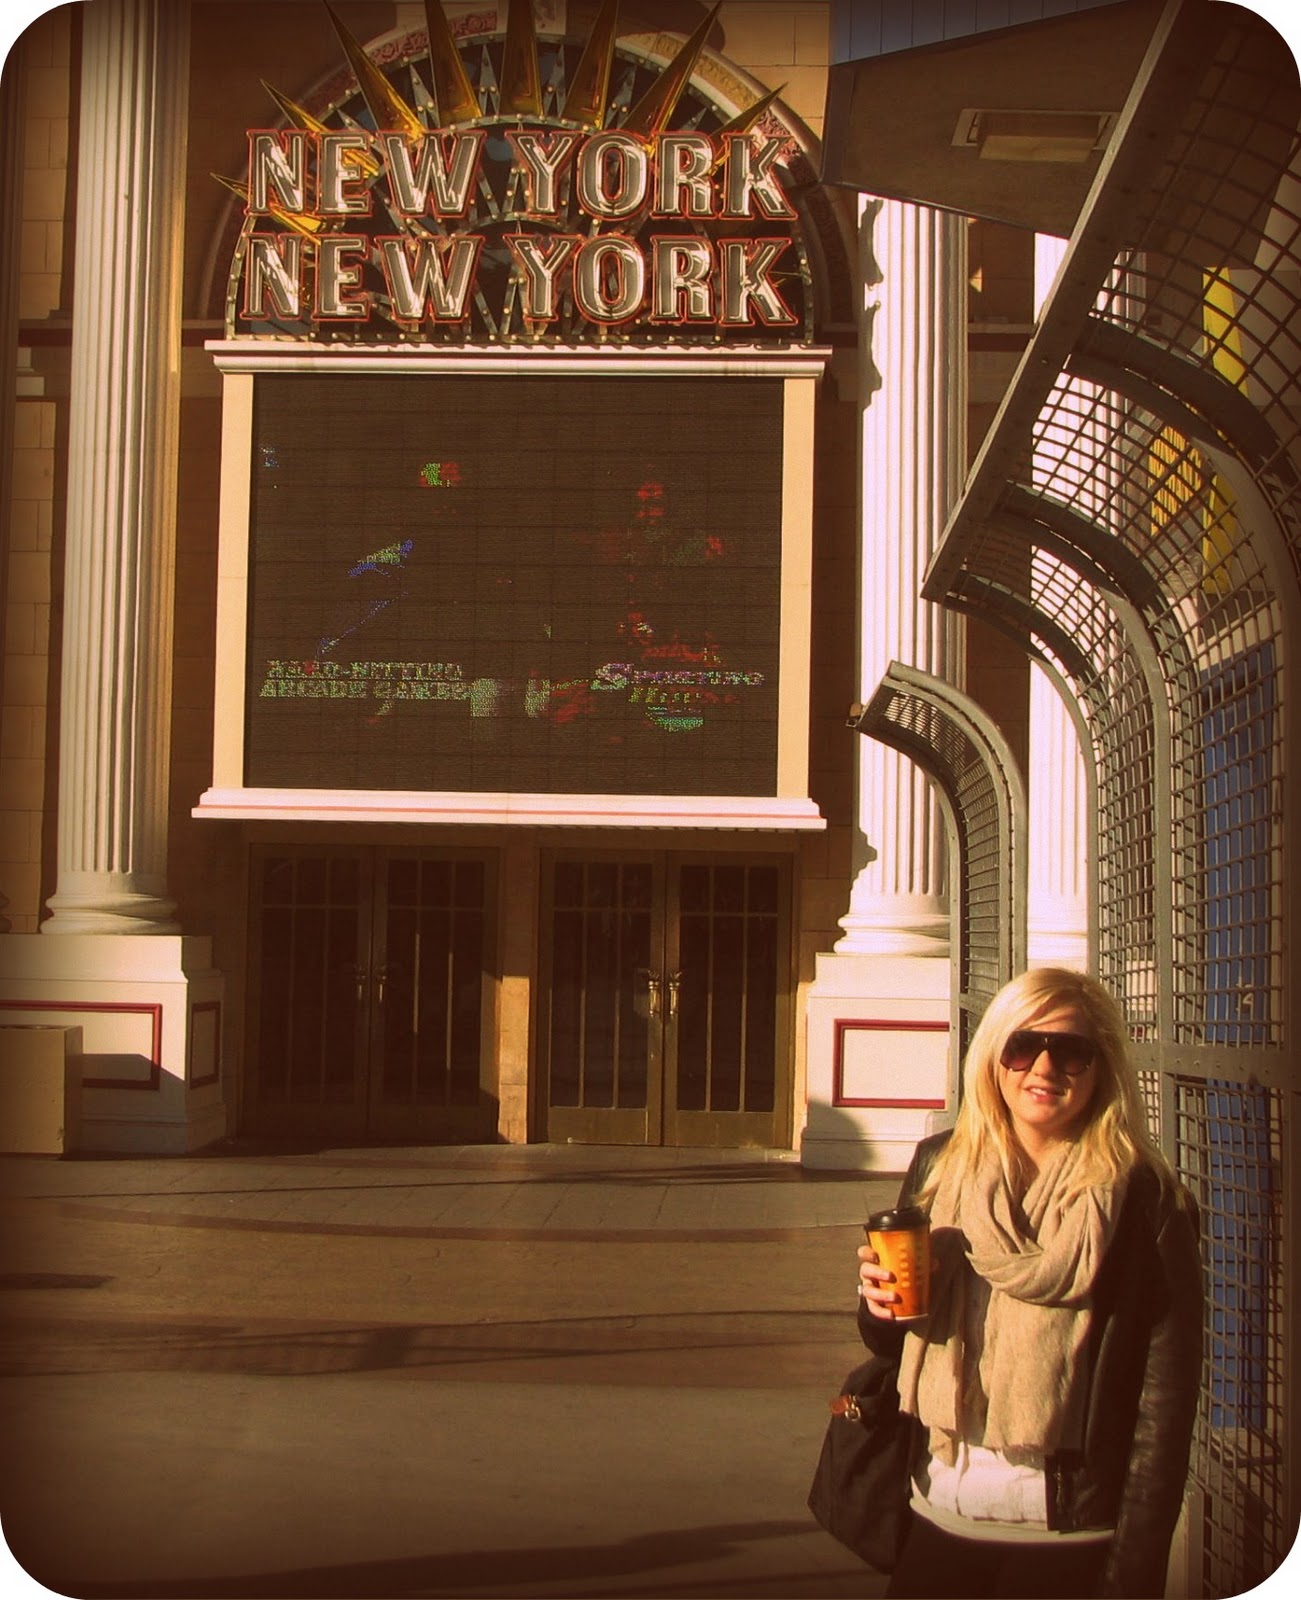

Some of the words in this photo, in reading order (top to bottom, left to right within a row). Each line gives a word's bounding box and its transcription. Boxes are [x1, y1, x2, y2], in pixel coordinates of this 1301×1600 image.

[246, 129, 487, 217] NEW
[505, 130, 798, 221] YORK
[240, 233, 486, 321] NEW
[503, 233, 798, 326] YORK
